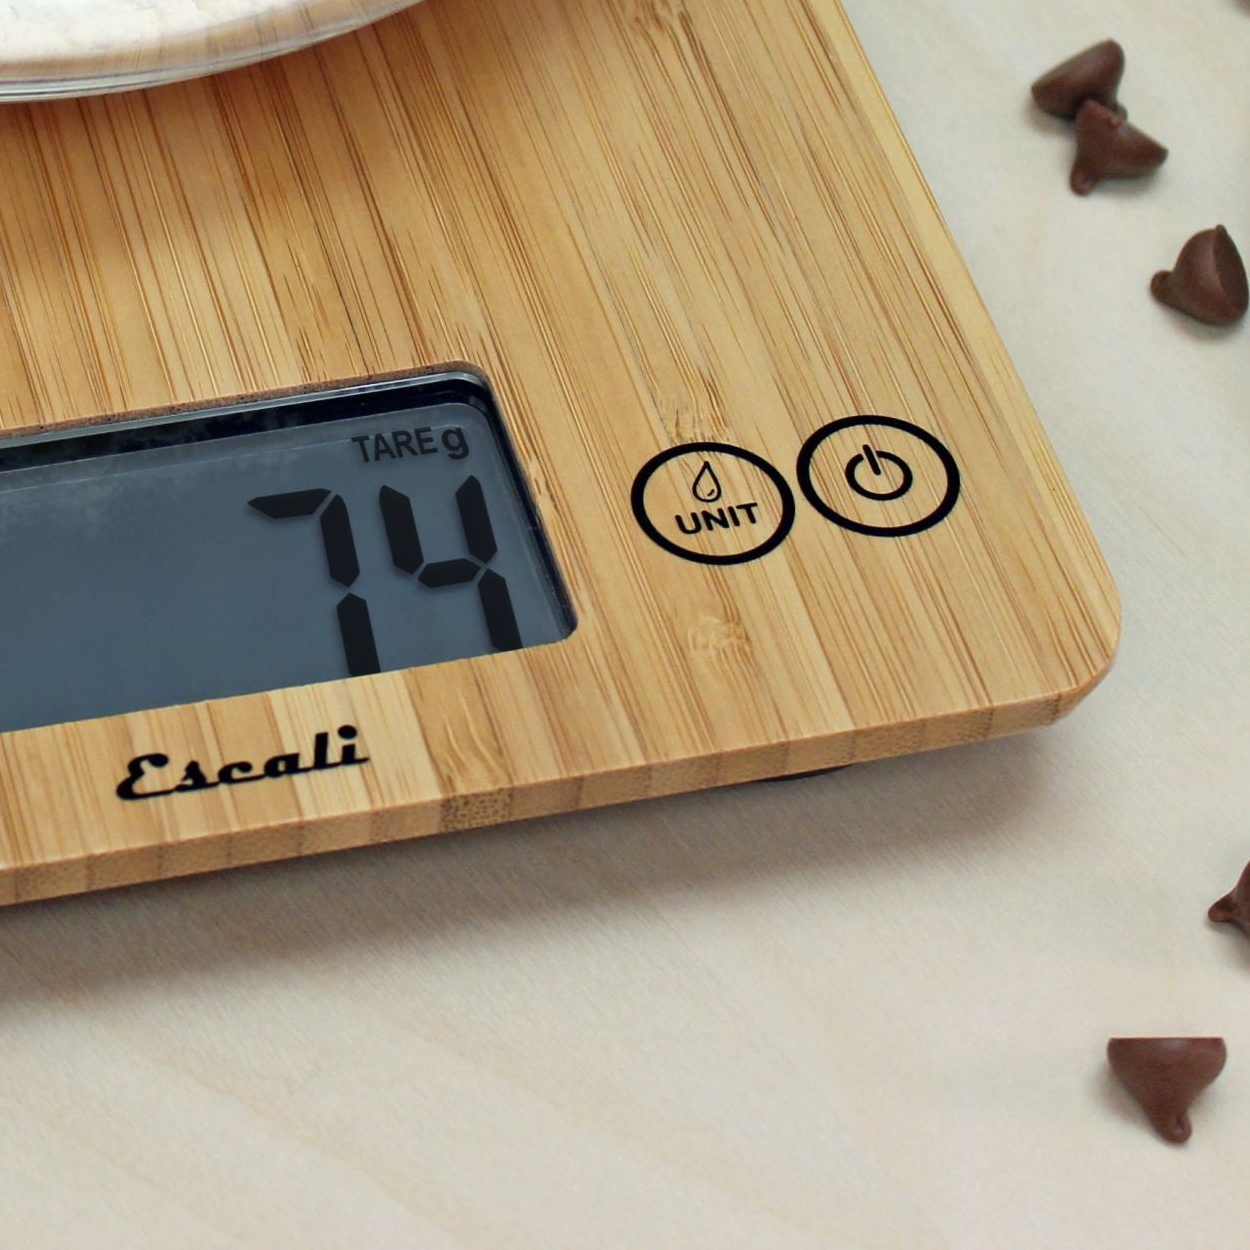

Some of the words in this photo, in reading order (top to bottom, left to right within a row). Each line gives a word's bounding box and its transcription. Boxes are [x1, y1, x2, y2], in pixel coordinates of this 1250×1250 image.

[352, 426, 438, 464] TARE
[440, 425, 471, 462] g
[674, 502, 758, 535] UNIT
[247, 474, 523, 675] 74
[115, 724, 370, 802] Escali
